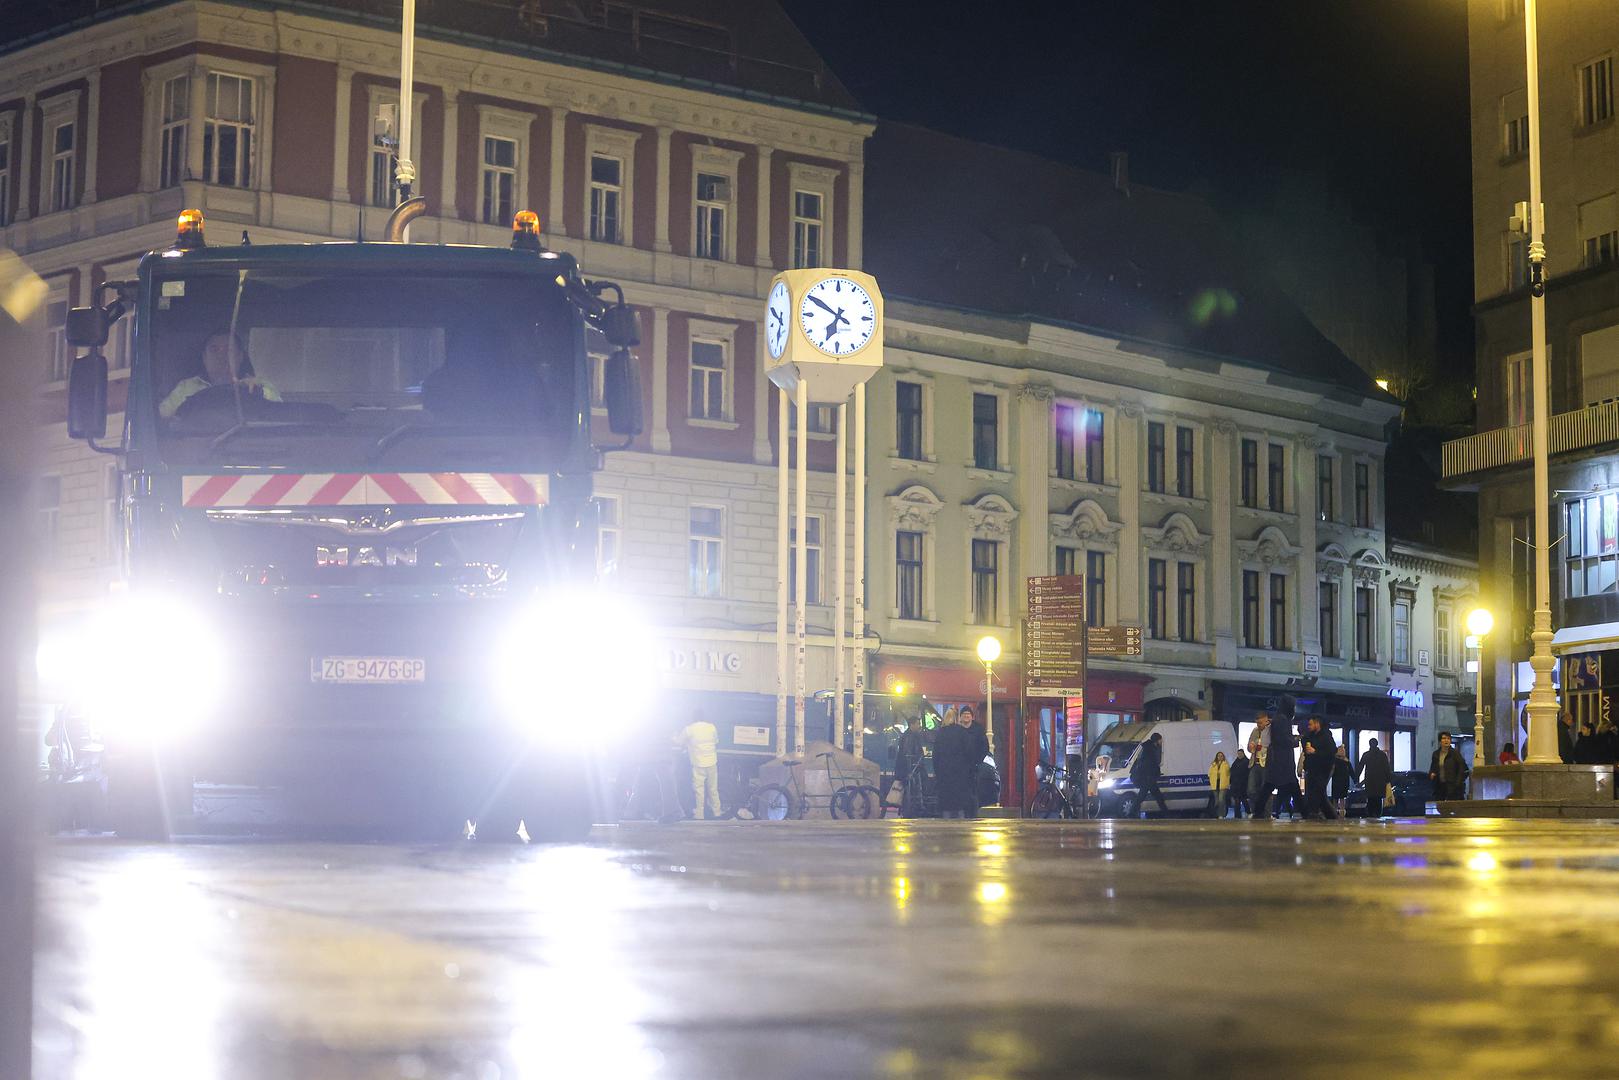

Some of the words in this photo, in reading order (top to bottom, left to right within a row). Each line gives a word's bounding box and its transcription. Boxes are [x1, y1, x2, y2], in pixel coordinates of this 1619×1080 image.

[317, 547, 417, 566] MAN
[324, 661, 345, 678] ZG
[668, 649, 741, 673] DING
